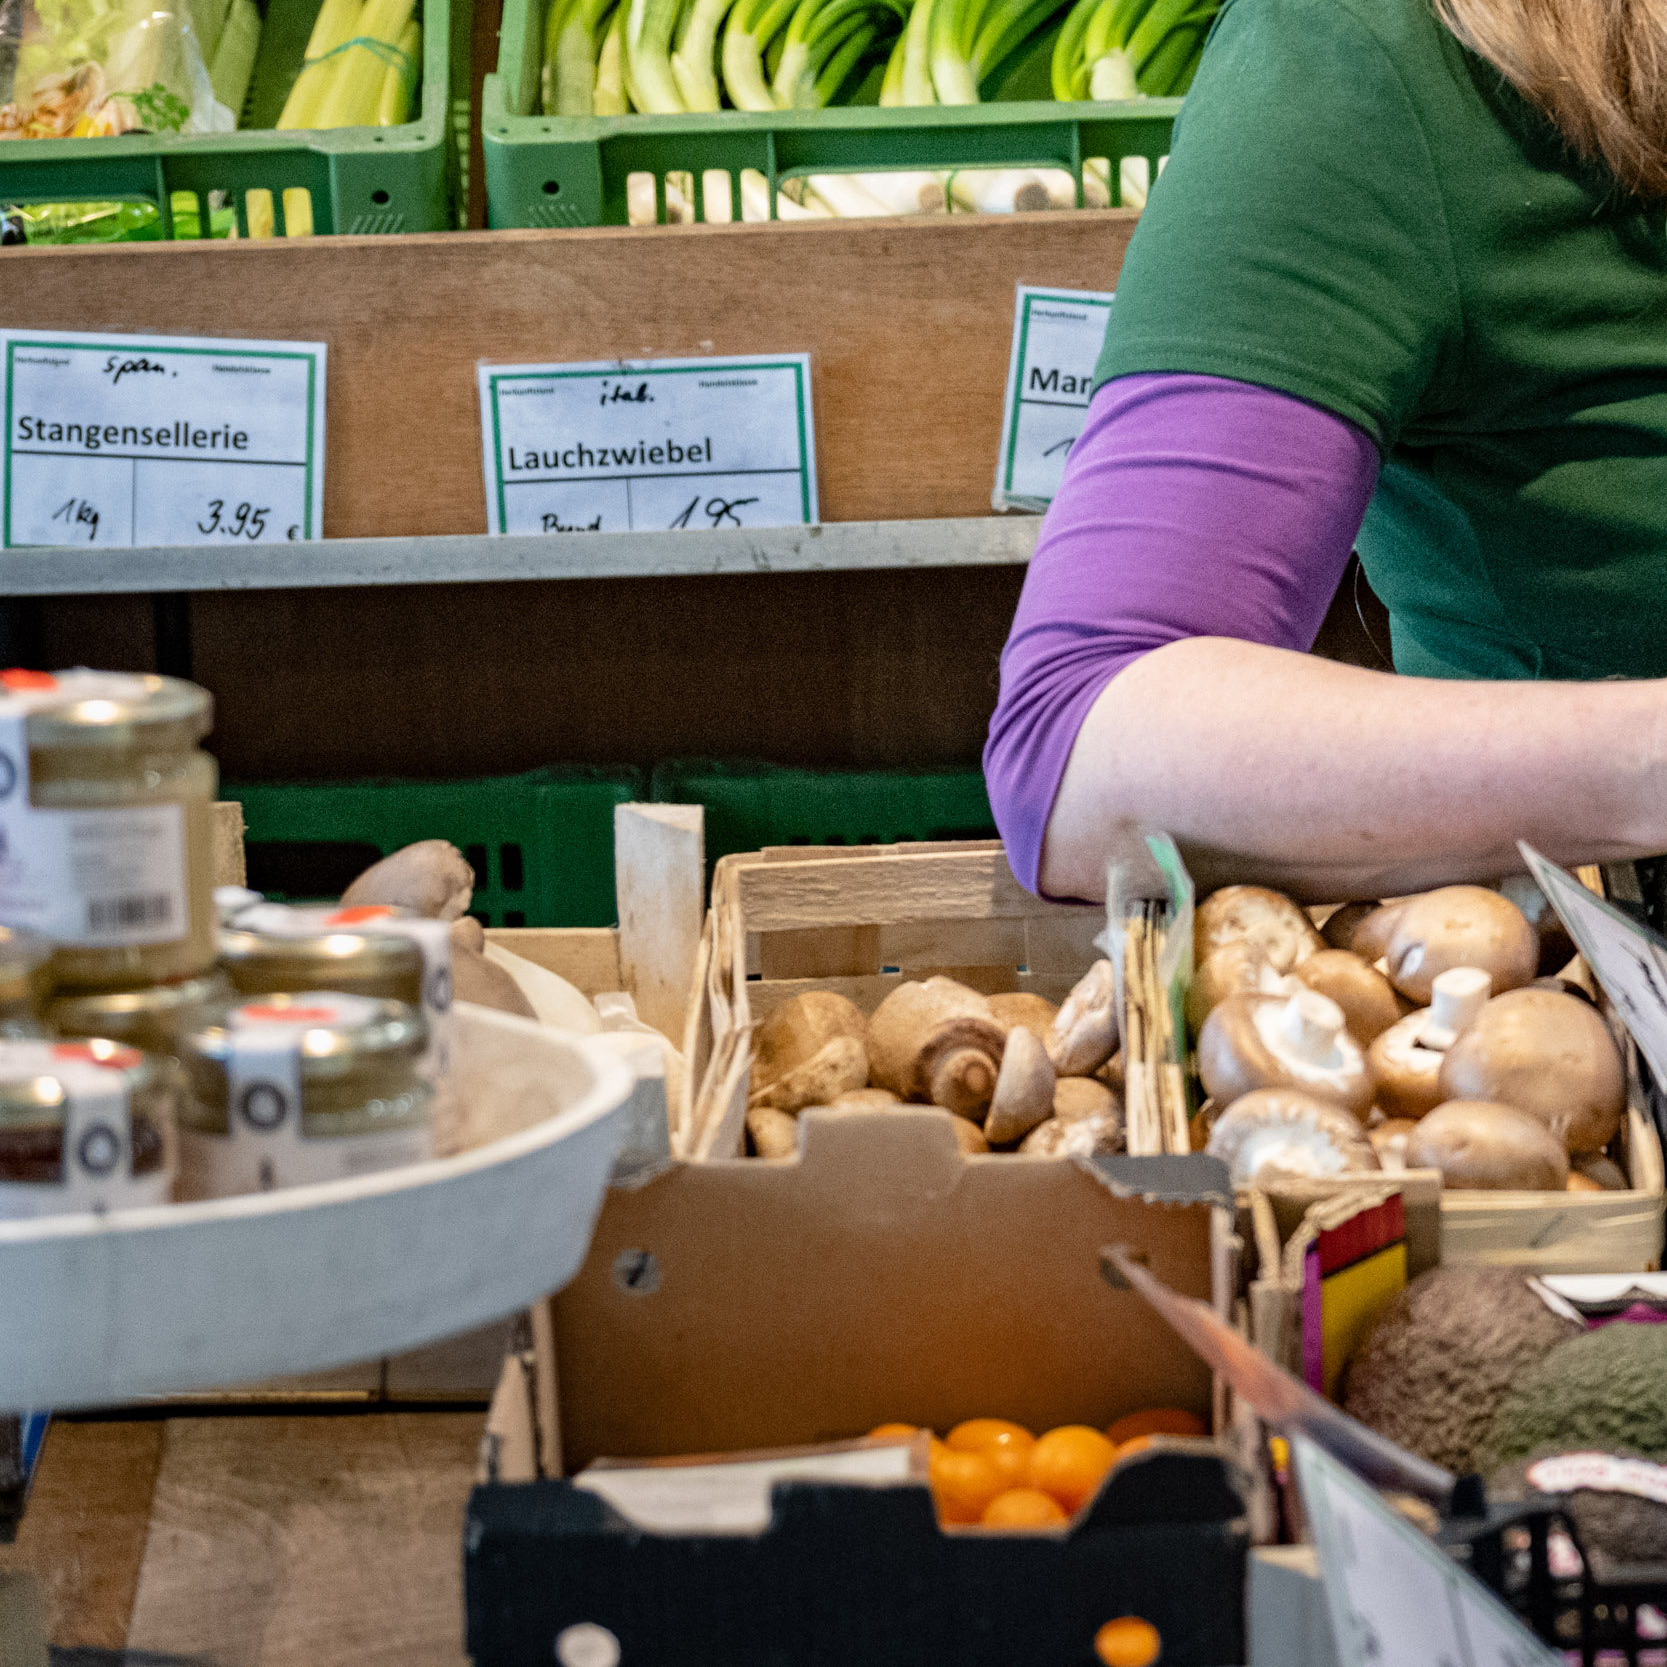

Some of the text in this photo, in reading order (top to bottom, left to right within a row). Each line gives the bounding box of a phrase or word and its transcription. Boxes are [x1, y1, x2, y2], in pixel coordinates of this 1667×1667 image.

[1029, 366, 1093, 394] Mar
[18, 416, 249, 450] Stangensellerie
[509, 437, 713, 473] Lauchzwiebel
[196, 499, 271, 540] 3.95
[287, 525, 299, 541] €
